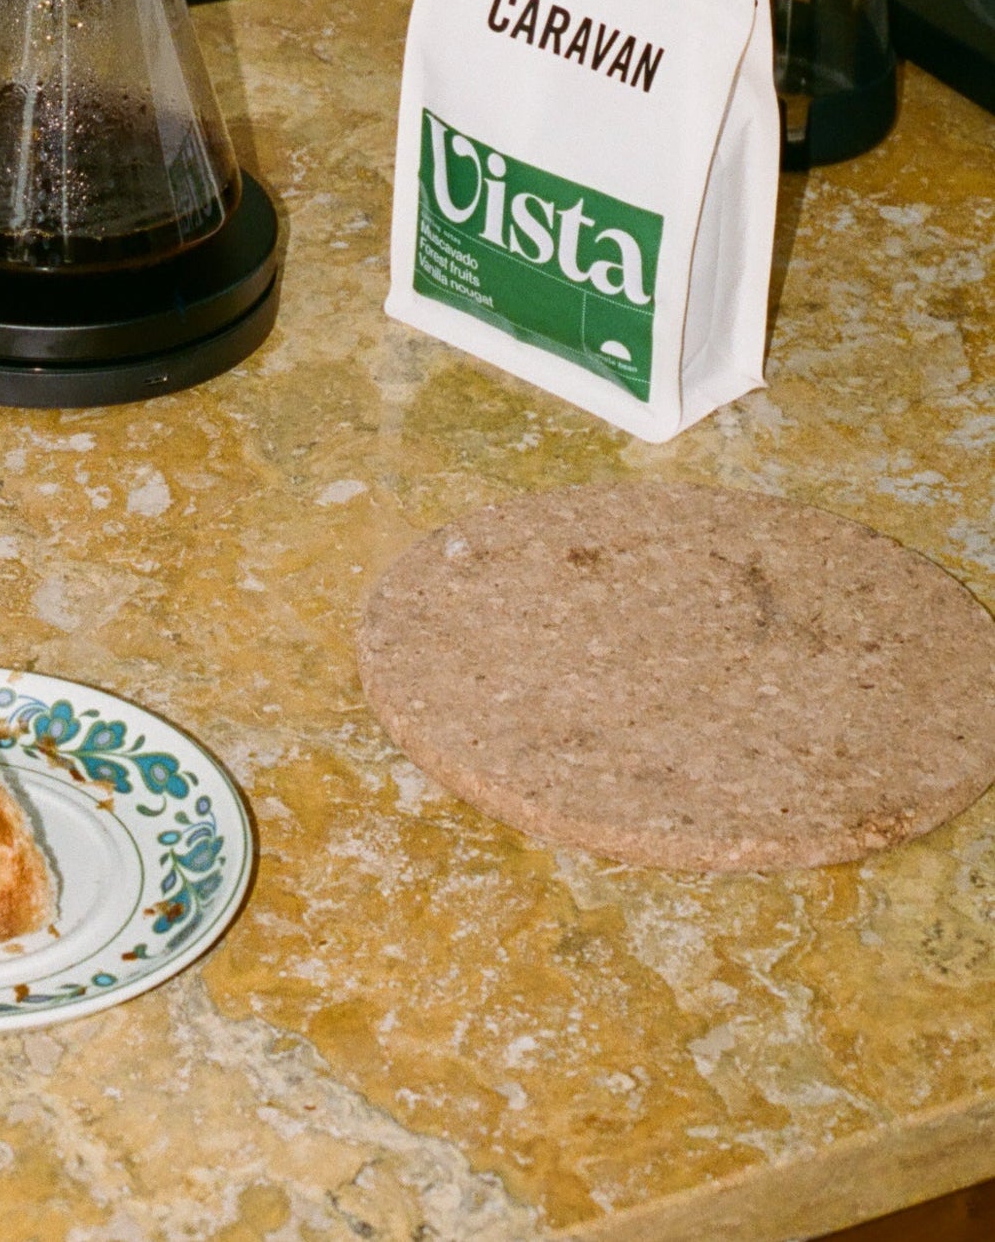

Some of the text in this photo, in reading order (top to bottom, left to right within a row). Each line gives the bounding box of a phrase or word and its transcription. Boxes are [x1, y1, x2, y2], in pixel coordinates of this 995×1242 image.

[426, 113, 652, 305] Vista
[418, 251, 494, 308] Vanilla nougat
[420, 236, 481, 287] Forest fruits
